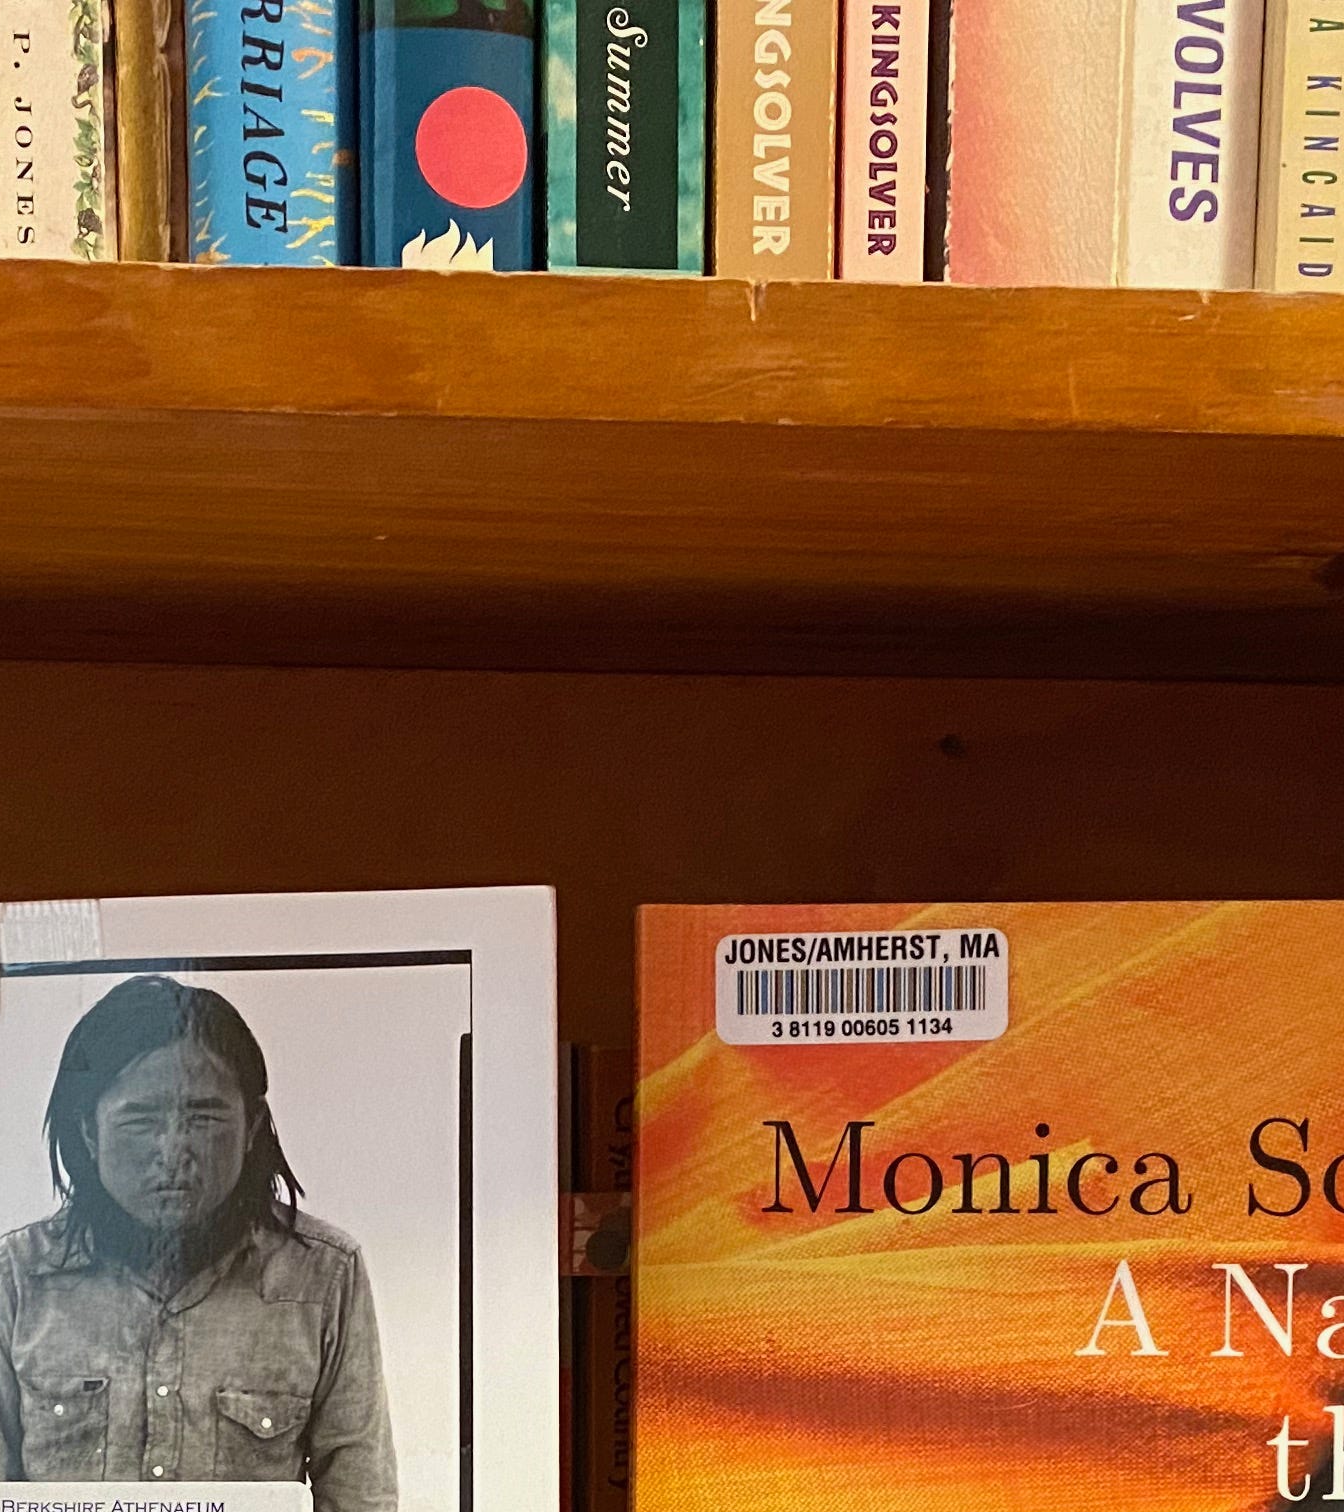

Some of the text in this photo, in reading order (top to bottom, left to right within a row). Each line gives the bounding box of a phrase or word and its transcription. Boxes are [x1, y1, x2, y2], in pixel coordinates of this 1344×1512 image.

[12, 31, 36, 246] P. JONES
[605, 6, 649, 212] Summer
[867, 5, 901, 256] KINGSOLVER
[1169, 0, 1226, 224] VOLVES
[1298, 76, 1343, 278] KINCAID
[724, 934, 1000, 966] JONES/AMHERST, MA
[772, 1017, 953, 1038] 3 8119 00605 1134
[761, 1120, 1192, 1216] Monica
[1074, 1260, 1167, 1358] A
